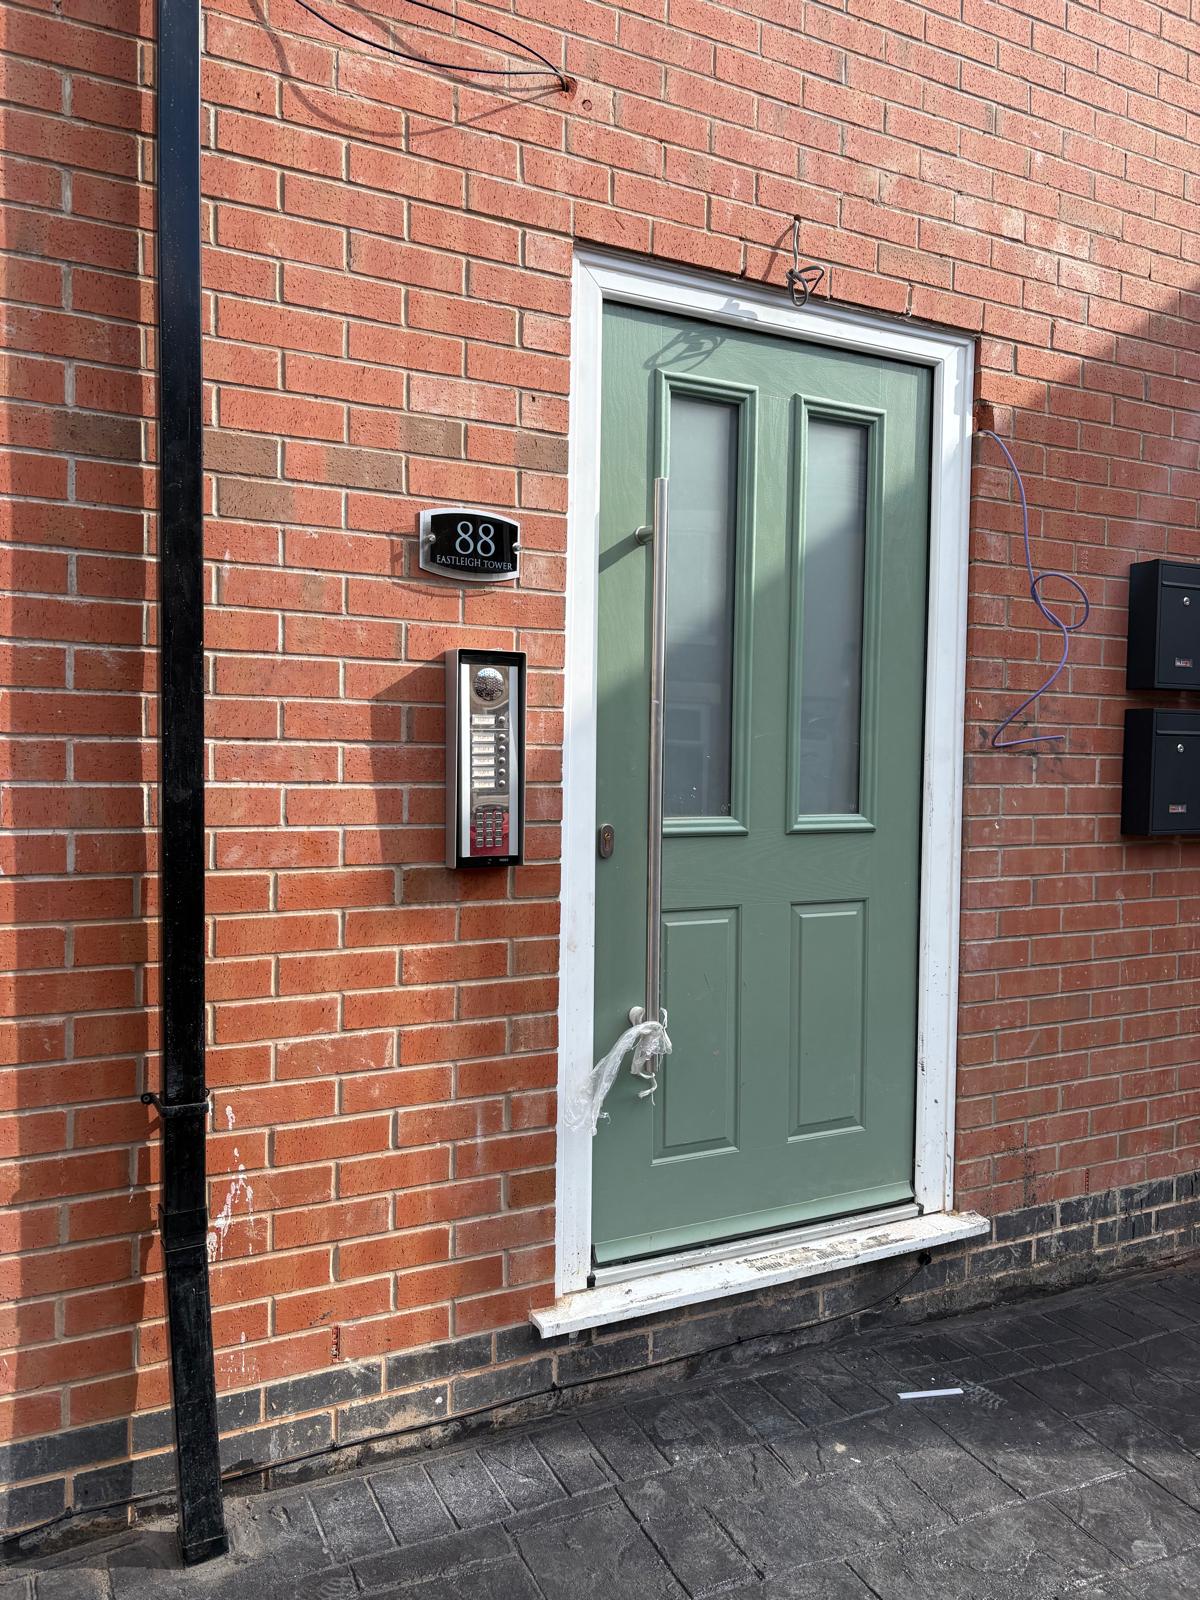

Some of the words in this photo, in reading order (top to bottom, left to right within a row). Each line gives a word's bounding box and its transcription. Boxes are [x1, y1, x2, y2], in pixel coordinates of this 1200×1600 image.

[455, 521, 495, 556] 88
[436, 555, 480, 567] EASTLEIGH
[483, 560, 512, 570] TOWER
